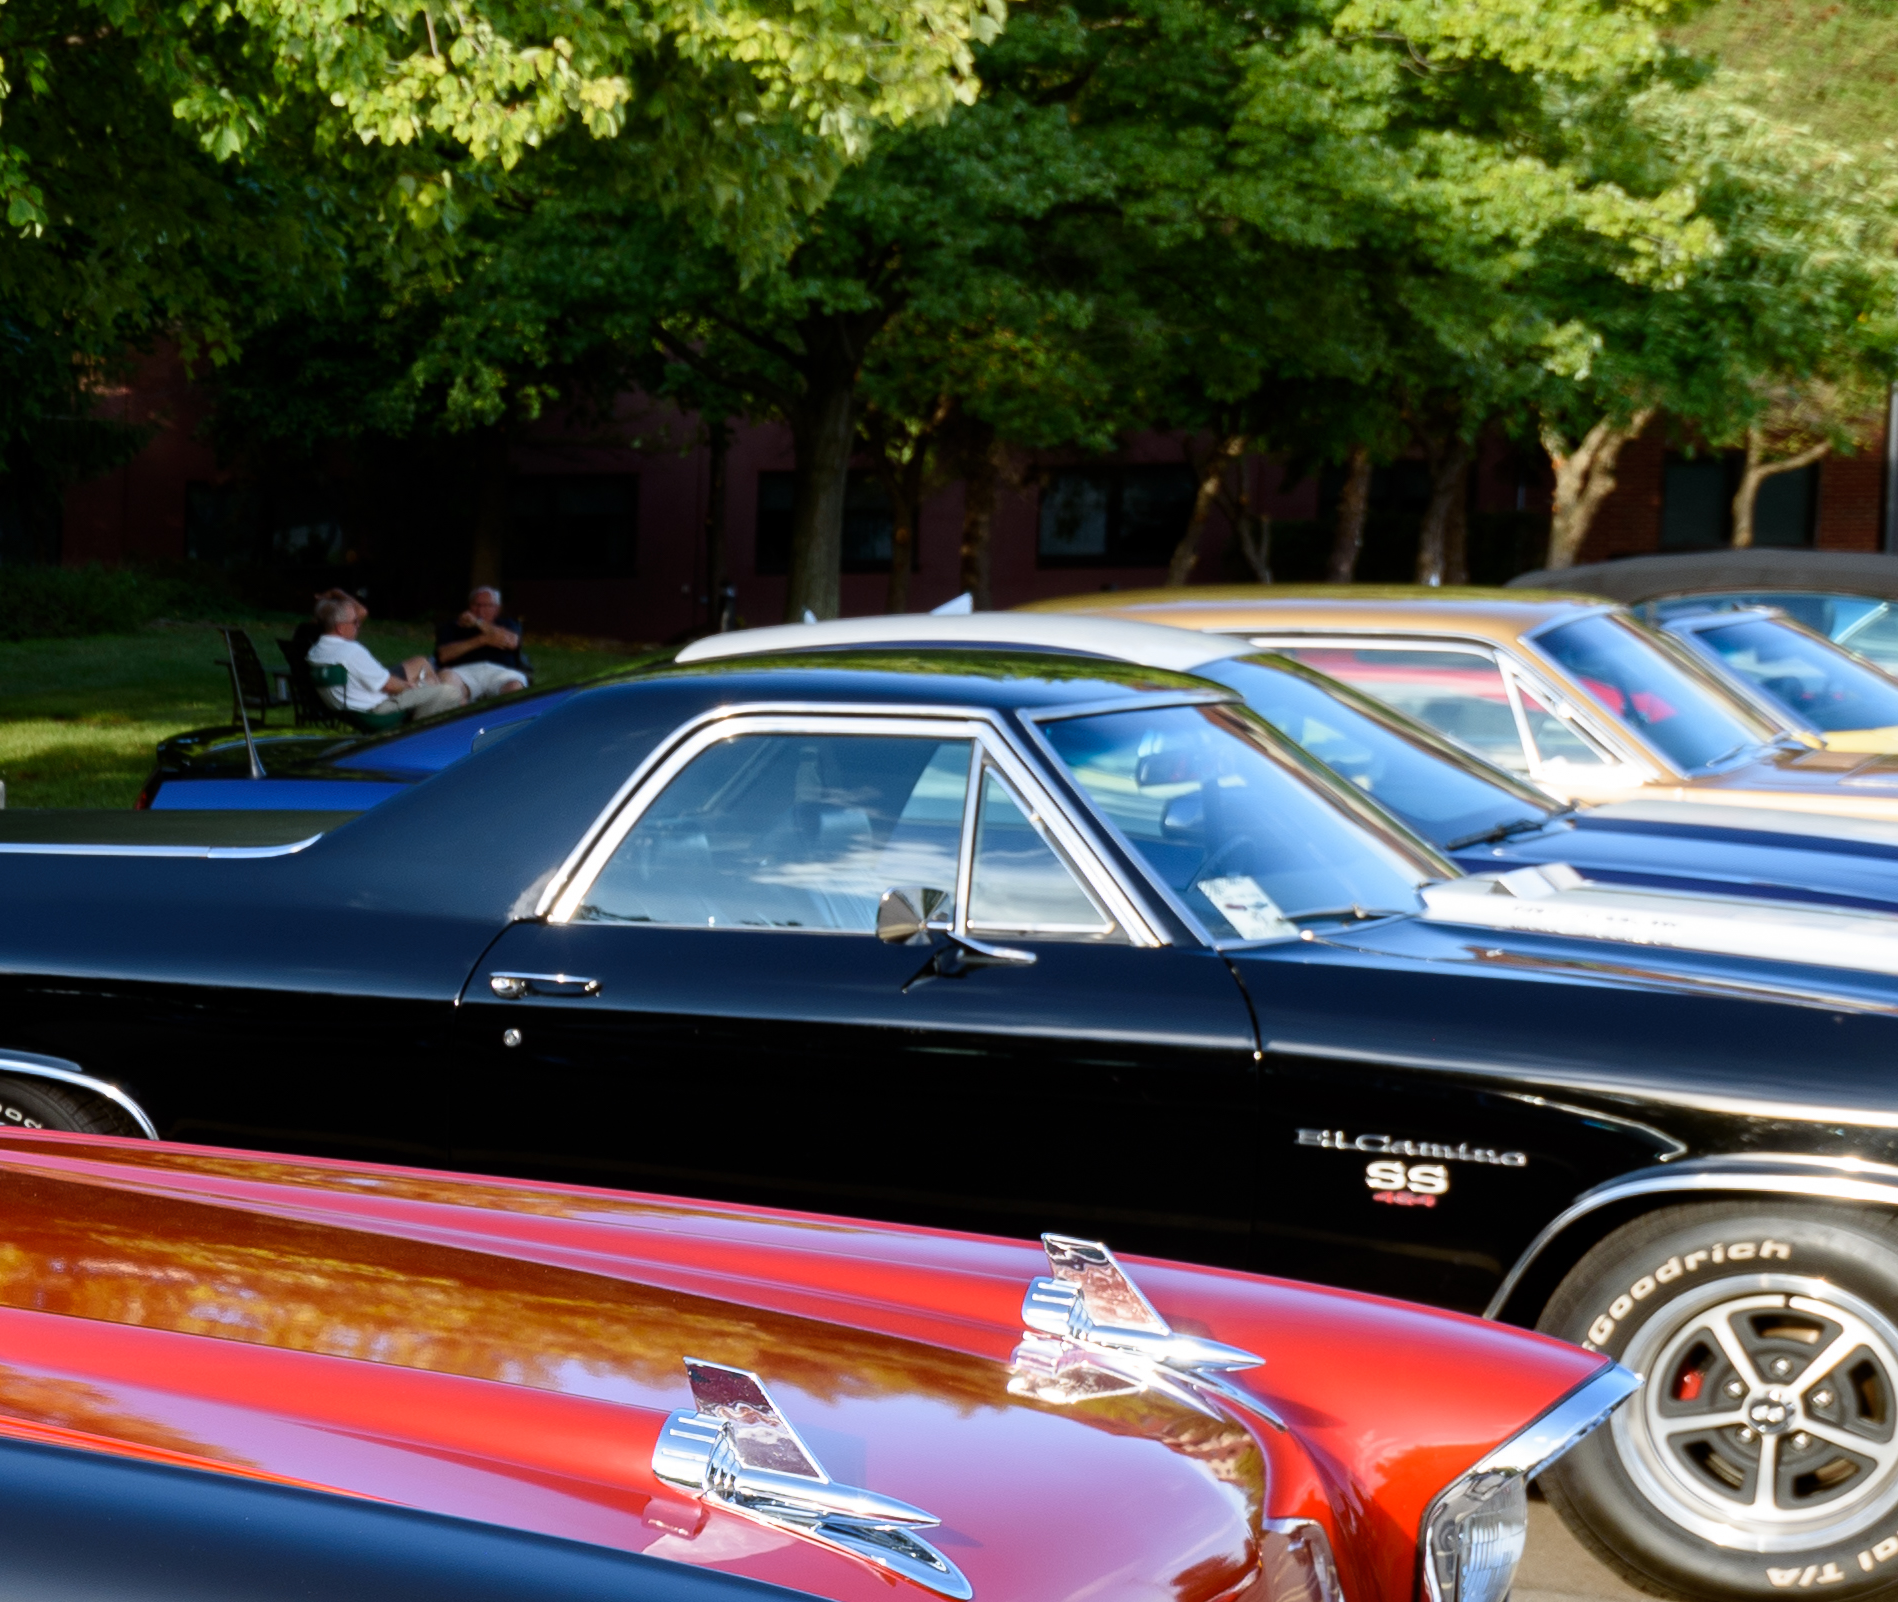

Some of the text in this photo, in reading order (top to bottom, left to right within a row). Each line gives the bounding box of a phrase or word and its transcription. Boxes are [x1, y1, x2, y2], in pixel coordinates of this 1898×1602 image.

[1355, 1133, 1527, 1167] Camino
[1365, 1160, 1449, 1195] SS
[1766, 1562, 1845, 1587] T/A
